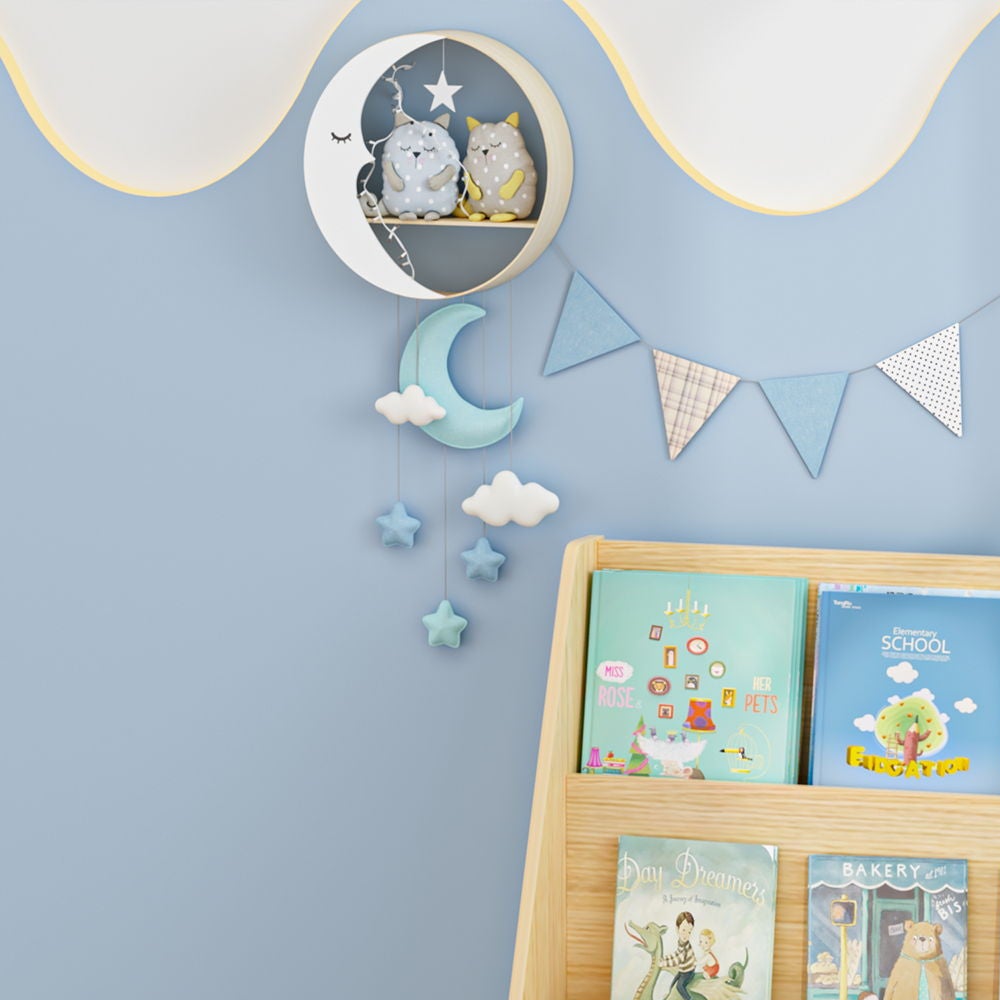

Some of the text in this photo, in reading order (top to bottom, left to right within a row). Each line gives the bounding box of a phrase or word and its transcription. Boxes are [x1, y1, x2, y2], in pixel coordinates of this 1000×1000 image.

[892, 626, 938, 639] Elementary
[881, 635, 951, 654] SCHOOL
[604, 665, 624, 678] MISS
[752, 676, 772, 691] HER
[597, 685, 636, 708] ROSE
[743, 693, 778, 714] PETS
[616, 847, 766, 905] Day Dreamers
[842, 862, 920, 879] BAKERY
